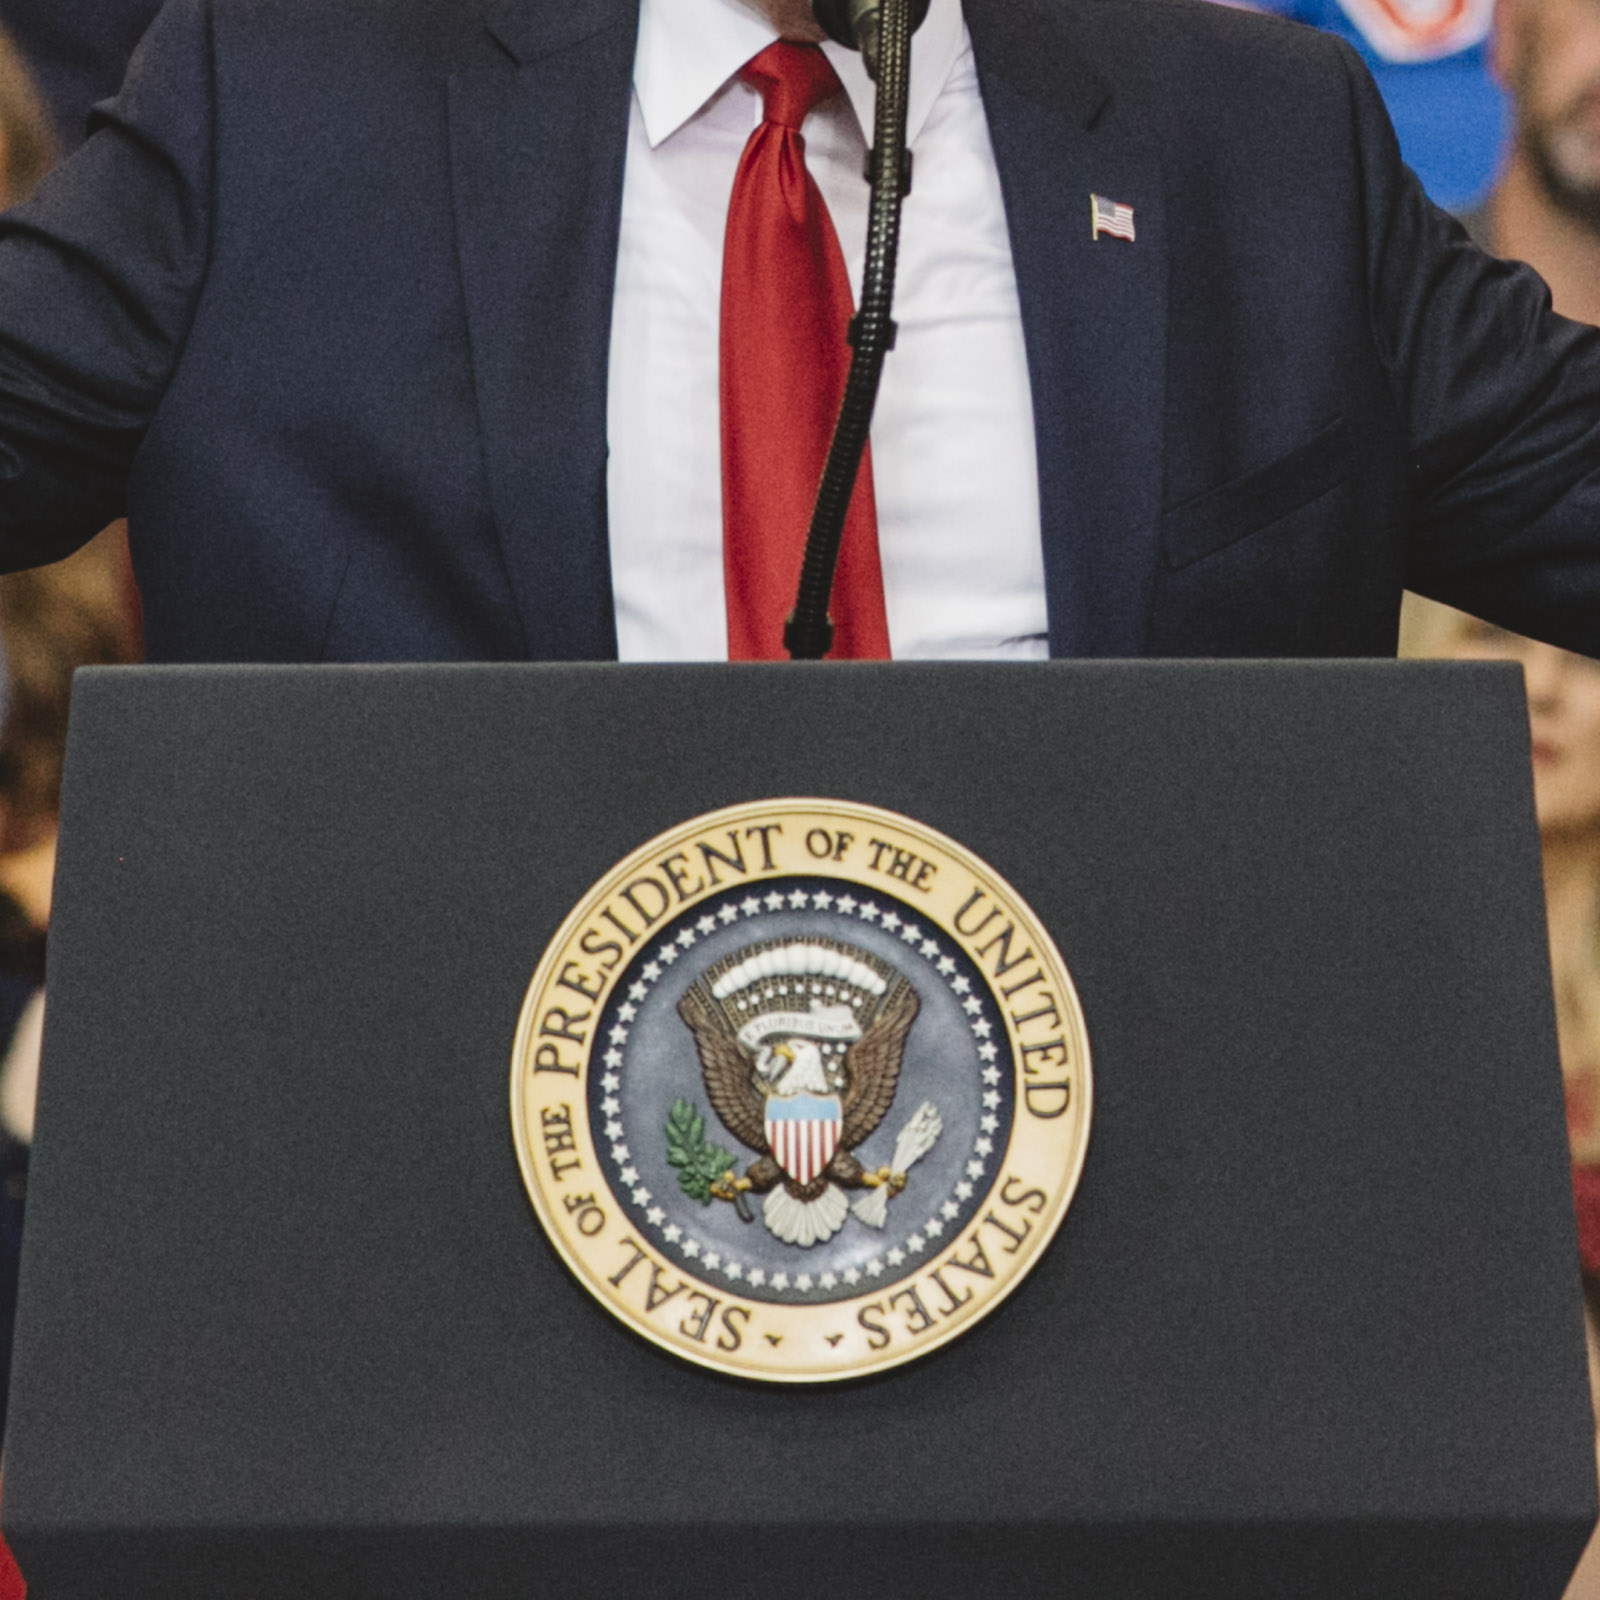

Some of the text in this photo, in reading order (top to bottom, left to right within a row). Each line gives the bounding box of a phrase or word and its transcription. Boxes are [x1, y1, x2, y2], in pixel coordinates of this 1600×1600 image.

[533, 823, 1072, 1353] SEAL OF THE PRESIDENT OF THE UNITED STATES
